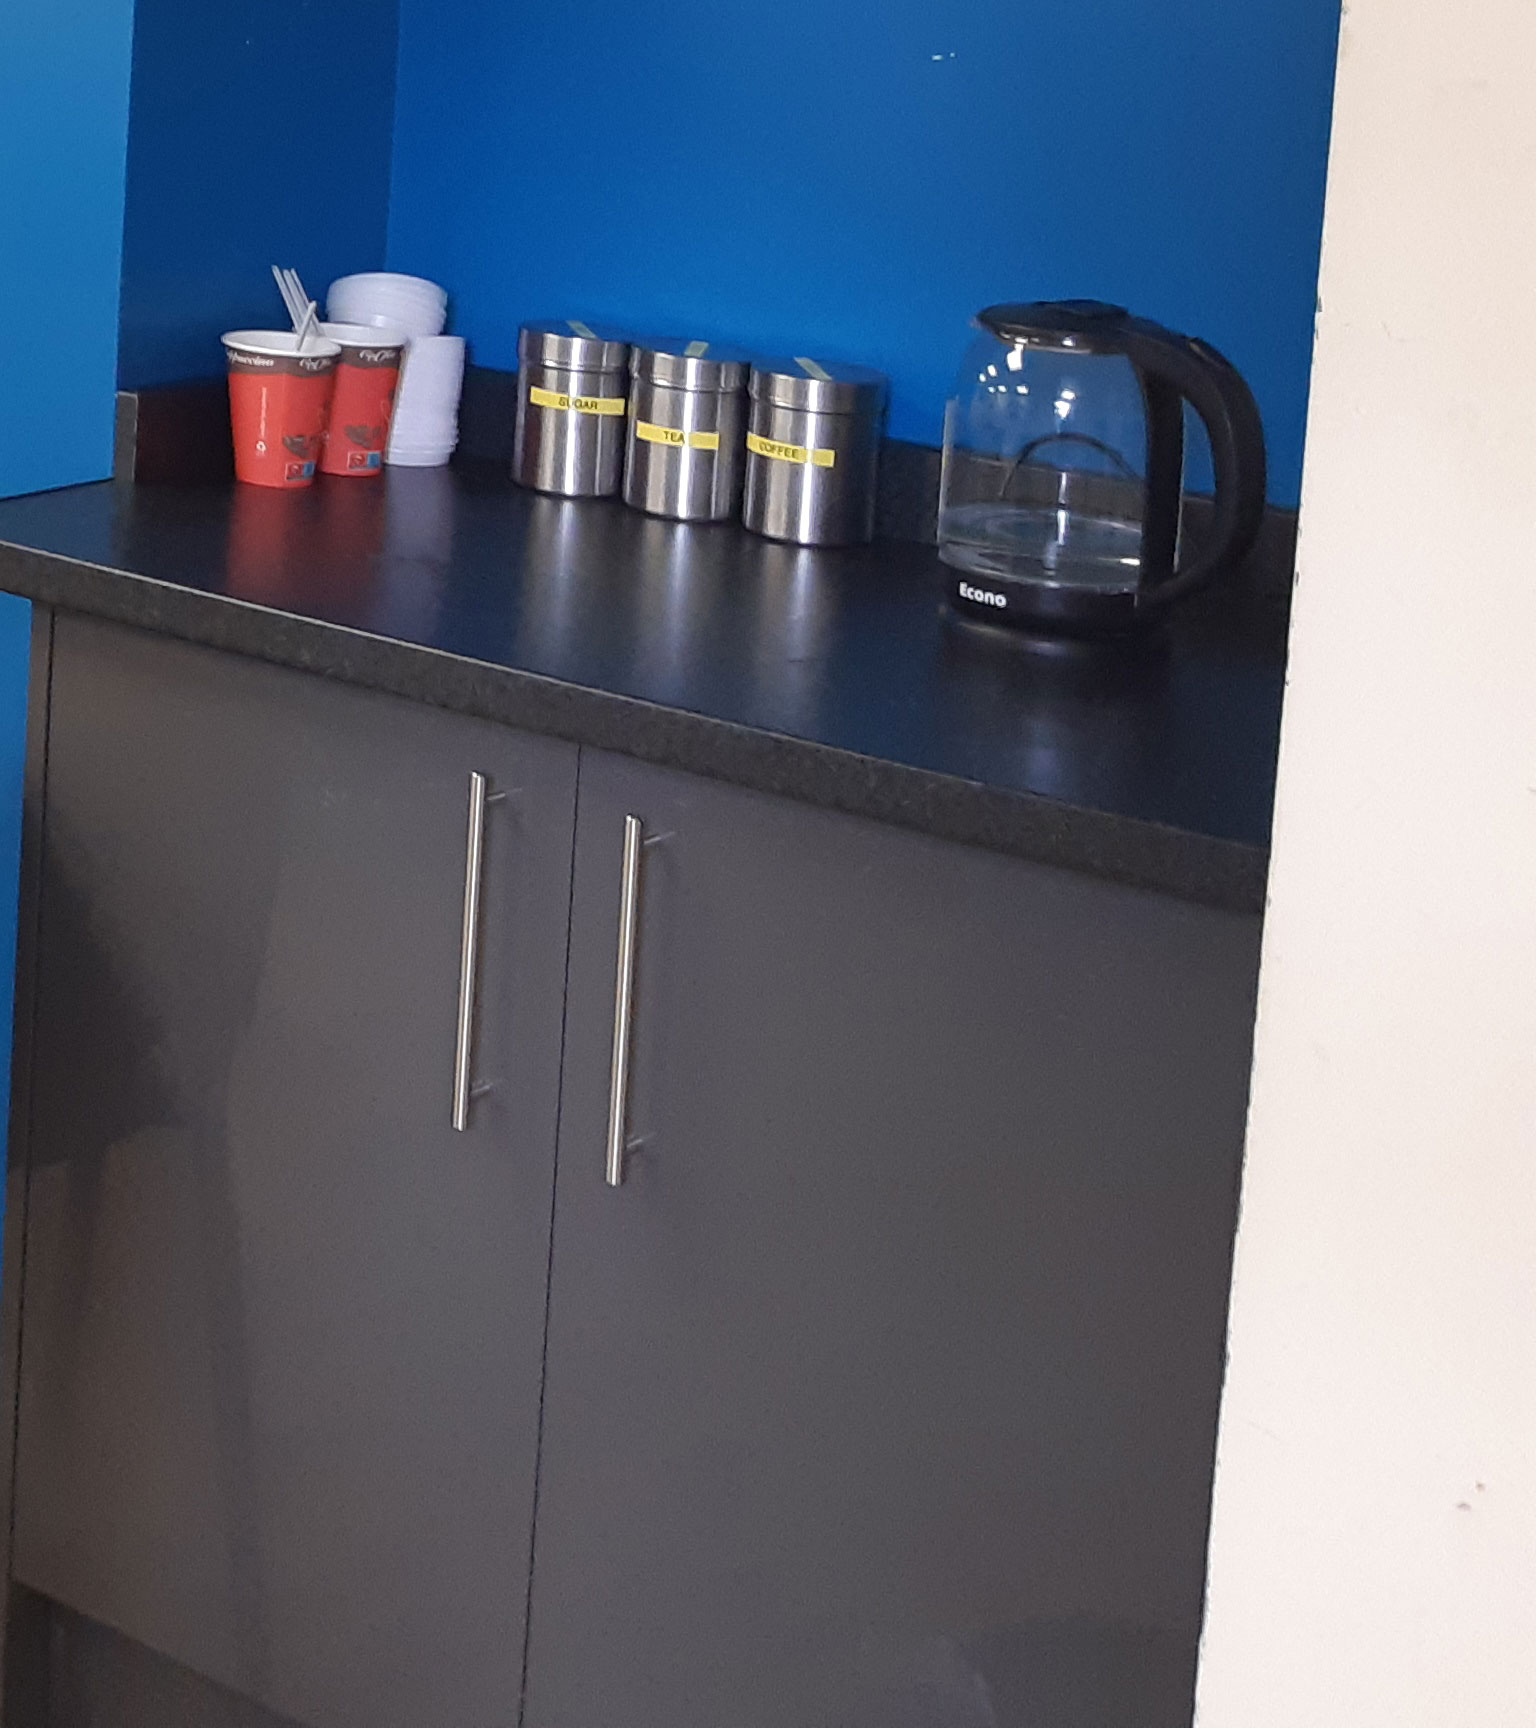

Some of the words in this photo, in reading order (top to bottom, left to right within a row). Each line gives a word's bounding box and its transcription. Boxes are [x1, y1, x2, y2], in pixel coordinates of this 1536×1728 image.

[663, 430, 686, 444] TEA
[758, 440, 800, 460] COFFEE
[959, 581, 1007, 608] Econo
